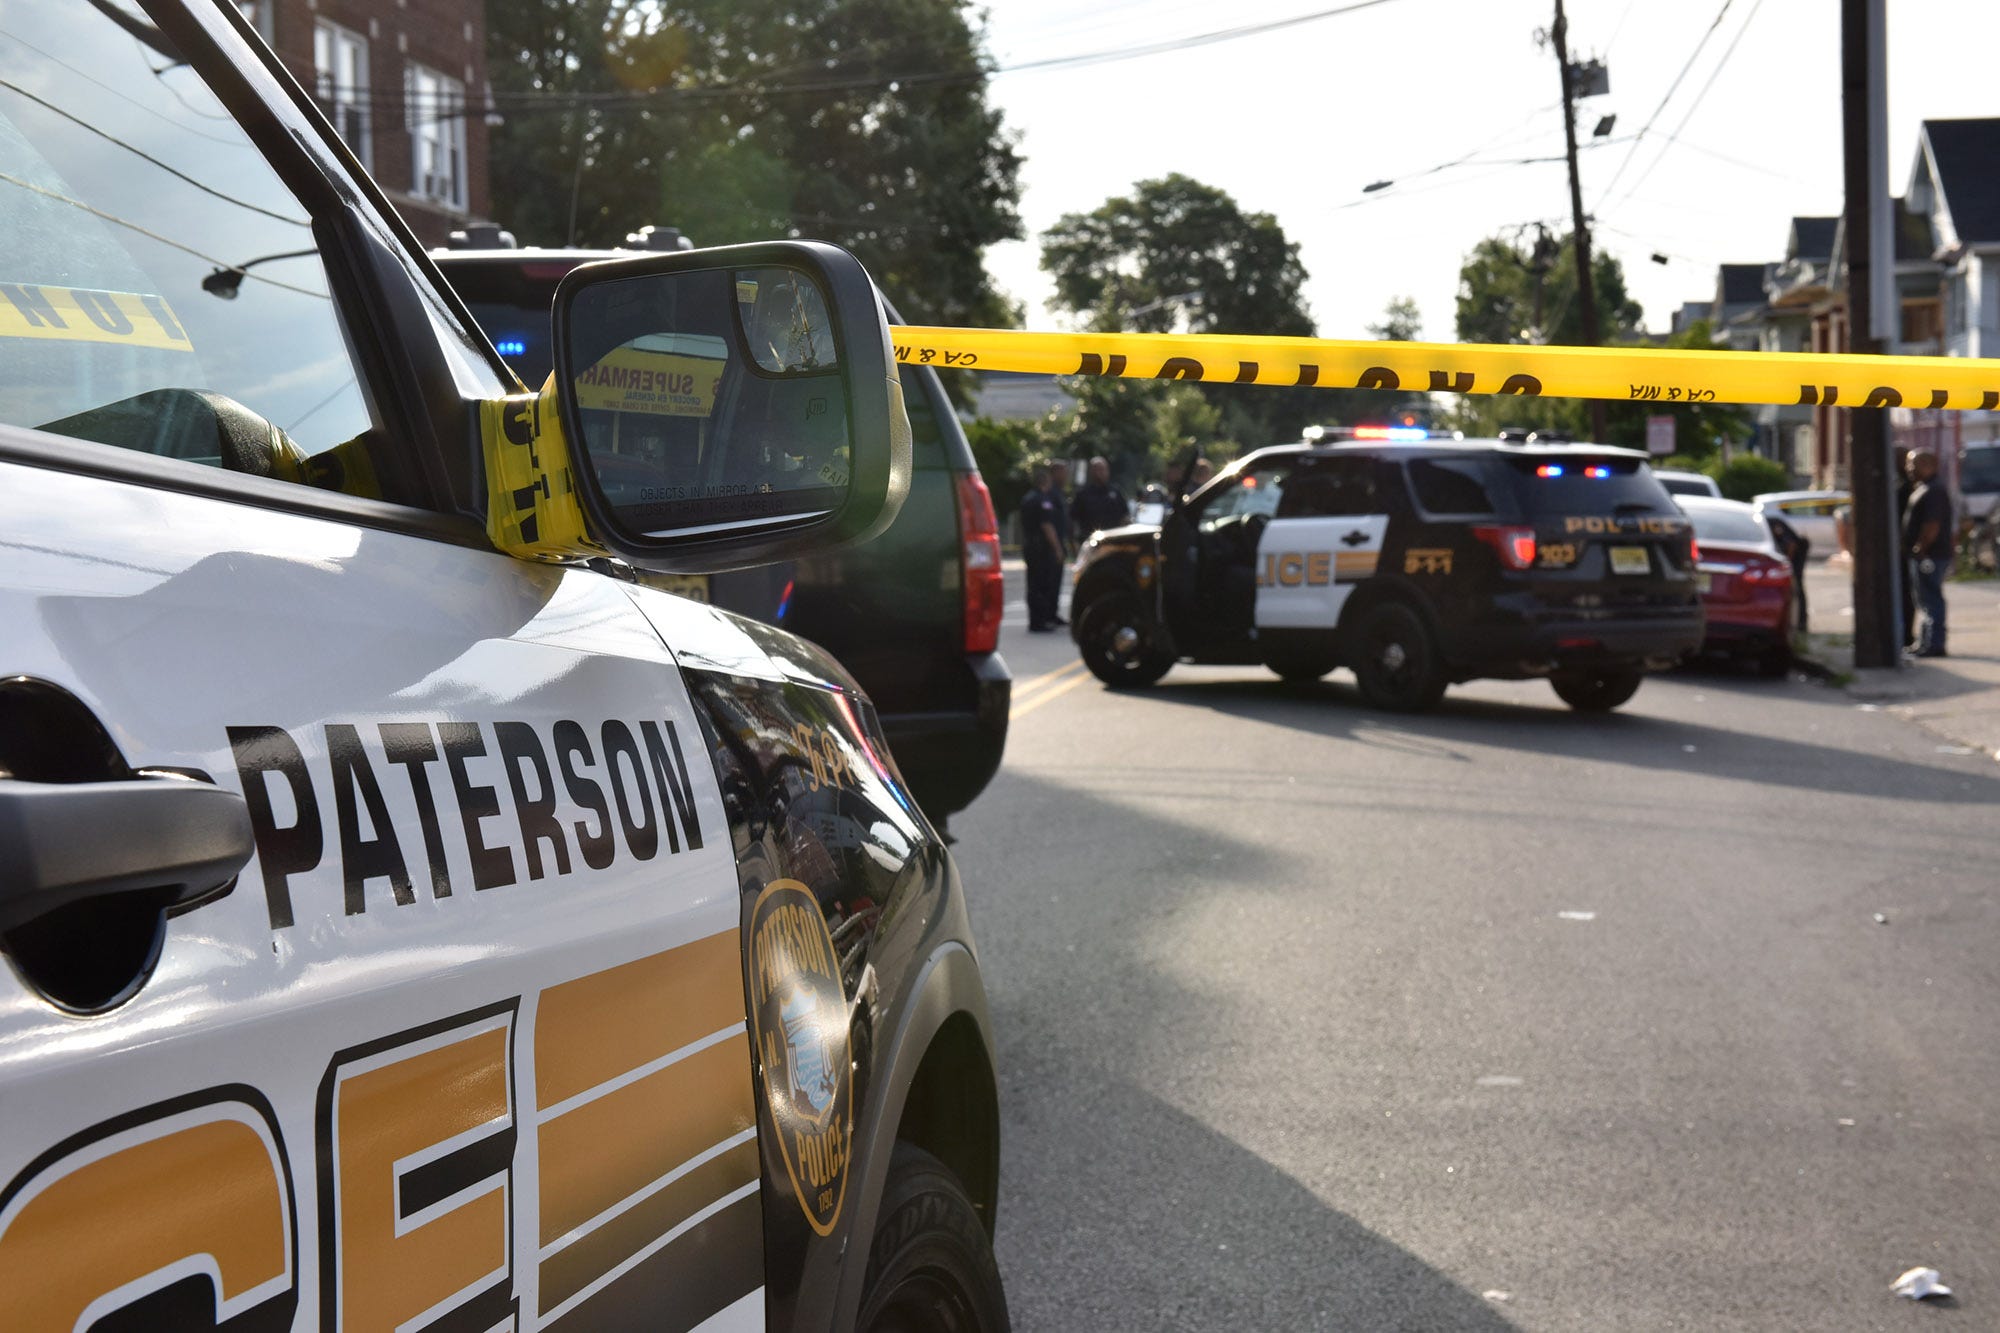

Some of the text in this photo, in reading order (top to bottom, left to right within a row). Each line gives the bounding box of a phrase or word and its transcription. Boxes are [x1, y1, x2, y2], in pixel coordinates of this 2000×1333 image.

[640, 486, 686, 500] OBJECTS
[690, 485, 700, 498] IN
[706, 484, 747, 498] MIRROR
[1564, 516, 1682, 534] POLICE
[1256, 552, 1331, 586] ICE
[226, 719, 704, 930] PATERSON
[756, 903, 832, 1006] PATERSON
[795, 1113, 846, 1189] POLICE
